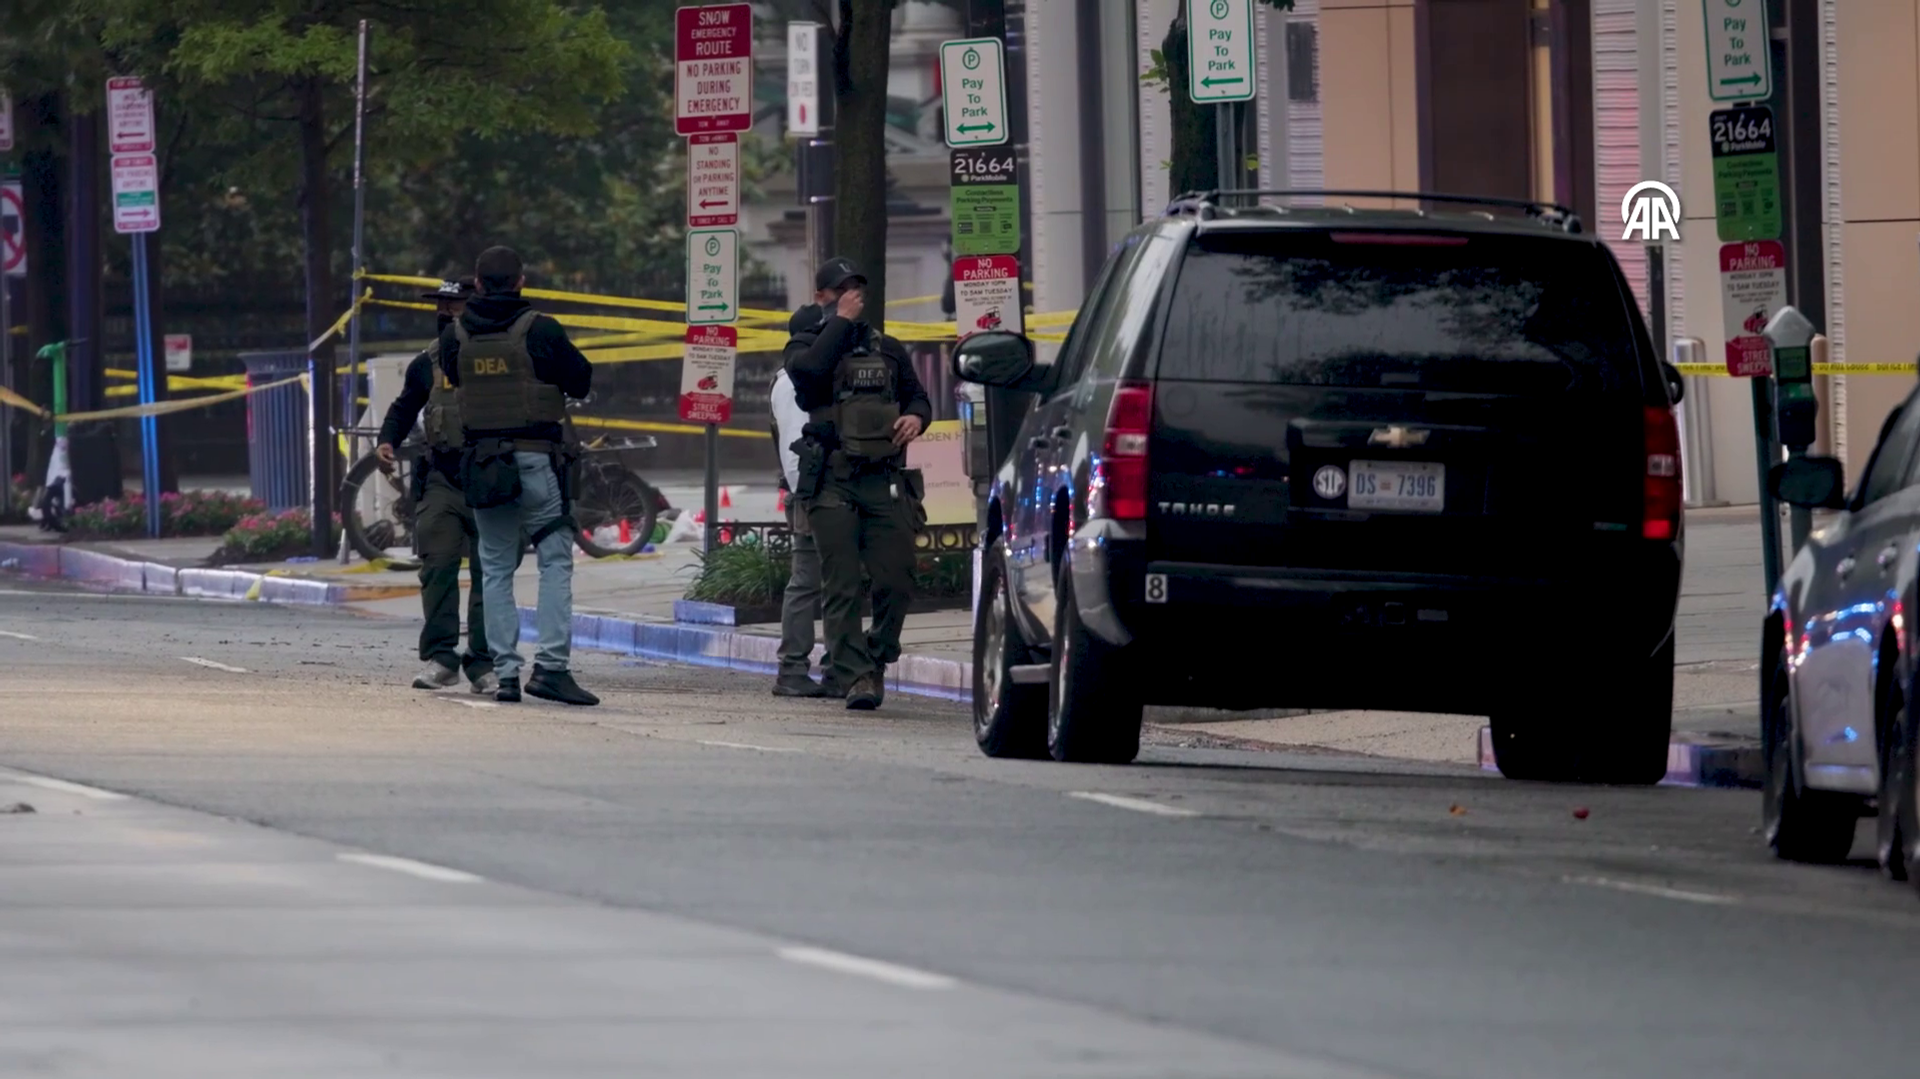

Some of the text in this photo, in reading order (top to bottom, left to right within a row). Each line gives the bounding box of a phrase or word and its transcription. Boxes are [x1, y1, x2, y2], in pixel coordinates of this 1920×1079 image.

[698, 10, 731, 26] SNOW
[1724, 18, 1746, 32] Pay
[691, 27, 737, 39] EMERGENCY
[1209, 29, 1232, 41] Pay
[696, 41, 732, 56] ROUTE
[1730, 37, 1744, 49] To
[1214, 46, 1229, 56] To
[1208, 60, 1236, 71] Park
[1724, 53, 1751, 66] Park
[687, 61, 742, 77] NO PARKING
[697, 80, 731, 95] DURING
[962, 78, 984, 90] Pay
[687, 97, 741, 113] EMERGENCY
[967, 94, 982, 104] To
[962, 107, 988, 118] Park
[1713, 118, 1771, 142] 21664
[708, 147, 719, 156] NO
[696, 160, 731, 170] STANDING
[954, 158, 1015, 173] 21664
[702, 172, 734, 183] PARKING
[698, 186, 729, 197] ANYTIME
[1744, 243, 1759, 256] NO
[703, 263, 722, 275] Pay
[977, 258, 993, 269] NO
[1729, 255, 1776, 271] PARKING
[963, 268, 1009, 280] PARKING
[1730, 272, 1756, 280] MONDAY
[707, 278, 719, 287] To
[1752, 281, 1780, 289] TUESDAY
[700, 290, 723, 299] Park
[706, 327, 719, 336] NO
[693, 335, 730, 346] PARKING
[1742, 350, 1769, 362] STREE
[474, 358, 508, 374] DEA
[858, 369, 885, 379] DEA
[692, 403, 719, 412] STREET
[687, 411, 722, 421] SWEEPING
[1355, 472, 1436, 497] DS 7396
[1158, 502, 1236, 516] TAHOE
[1147, 576, 1164, 600] 8
